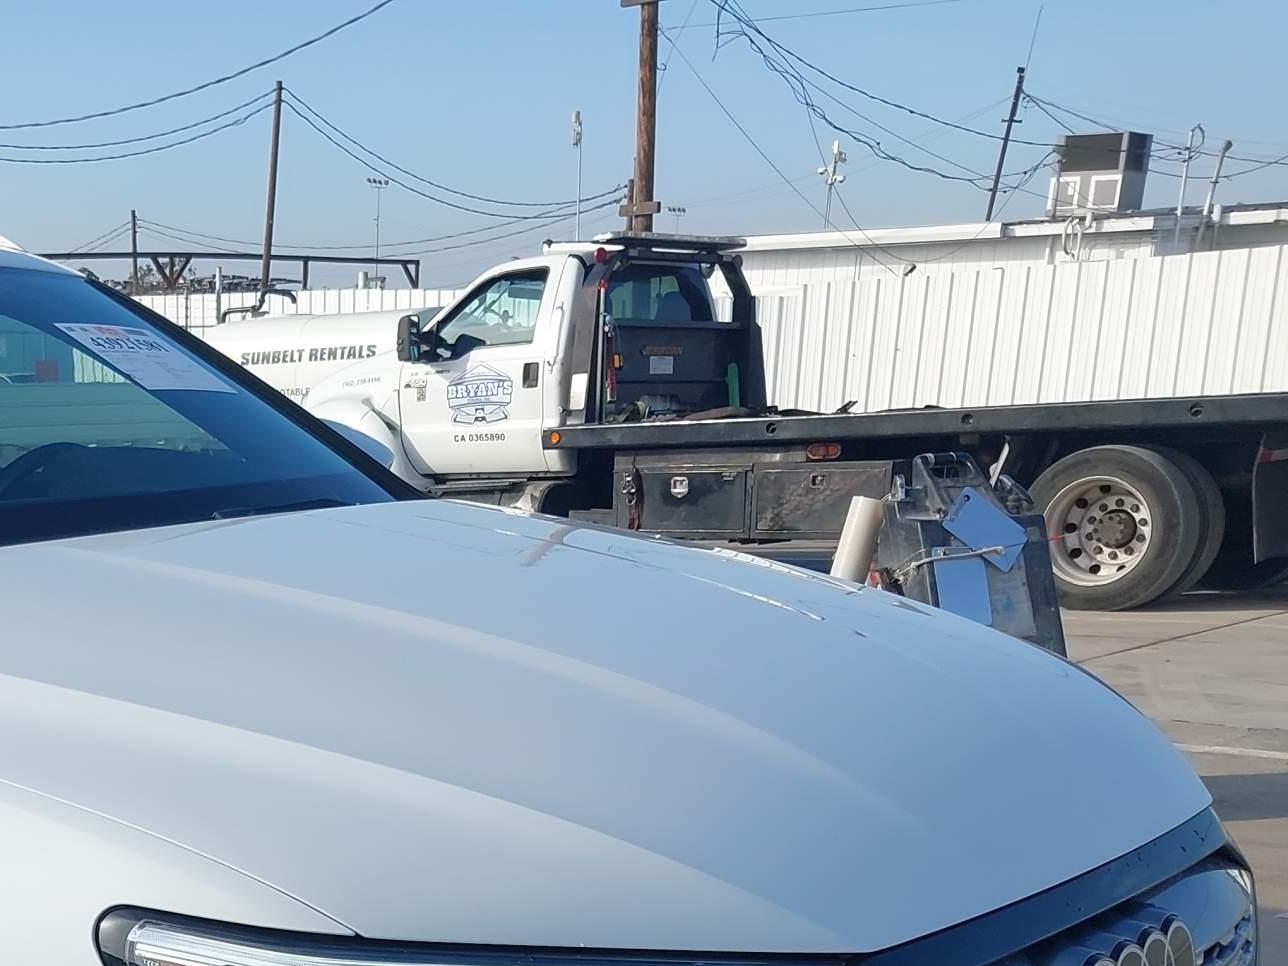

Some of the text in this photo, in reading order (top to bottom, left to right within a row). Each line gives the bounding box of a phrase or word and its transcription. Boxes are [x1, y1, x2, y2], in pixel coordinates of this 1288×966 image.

[89, 336, 170, 353] 43921581
[240, 344, 377, 366] SUNBELT RENTALS
[447, 380, 513, 399] BRYAN'S
[454, 433, 506, 442] CA 0365890
